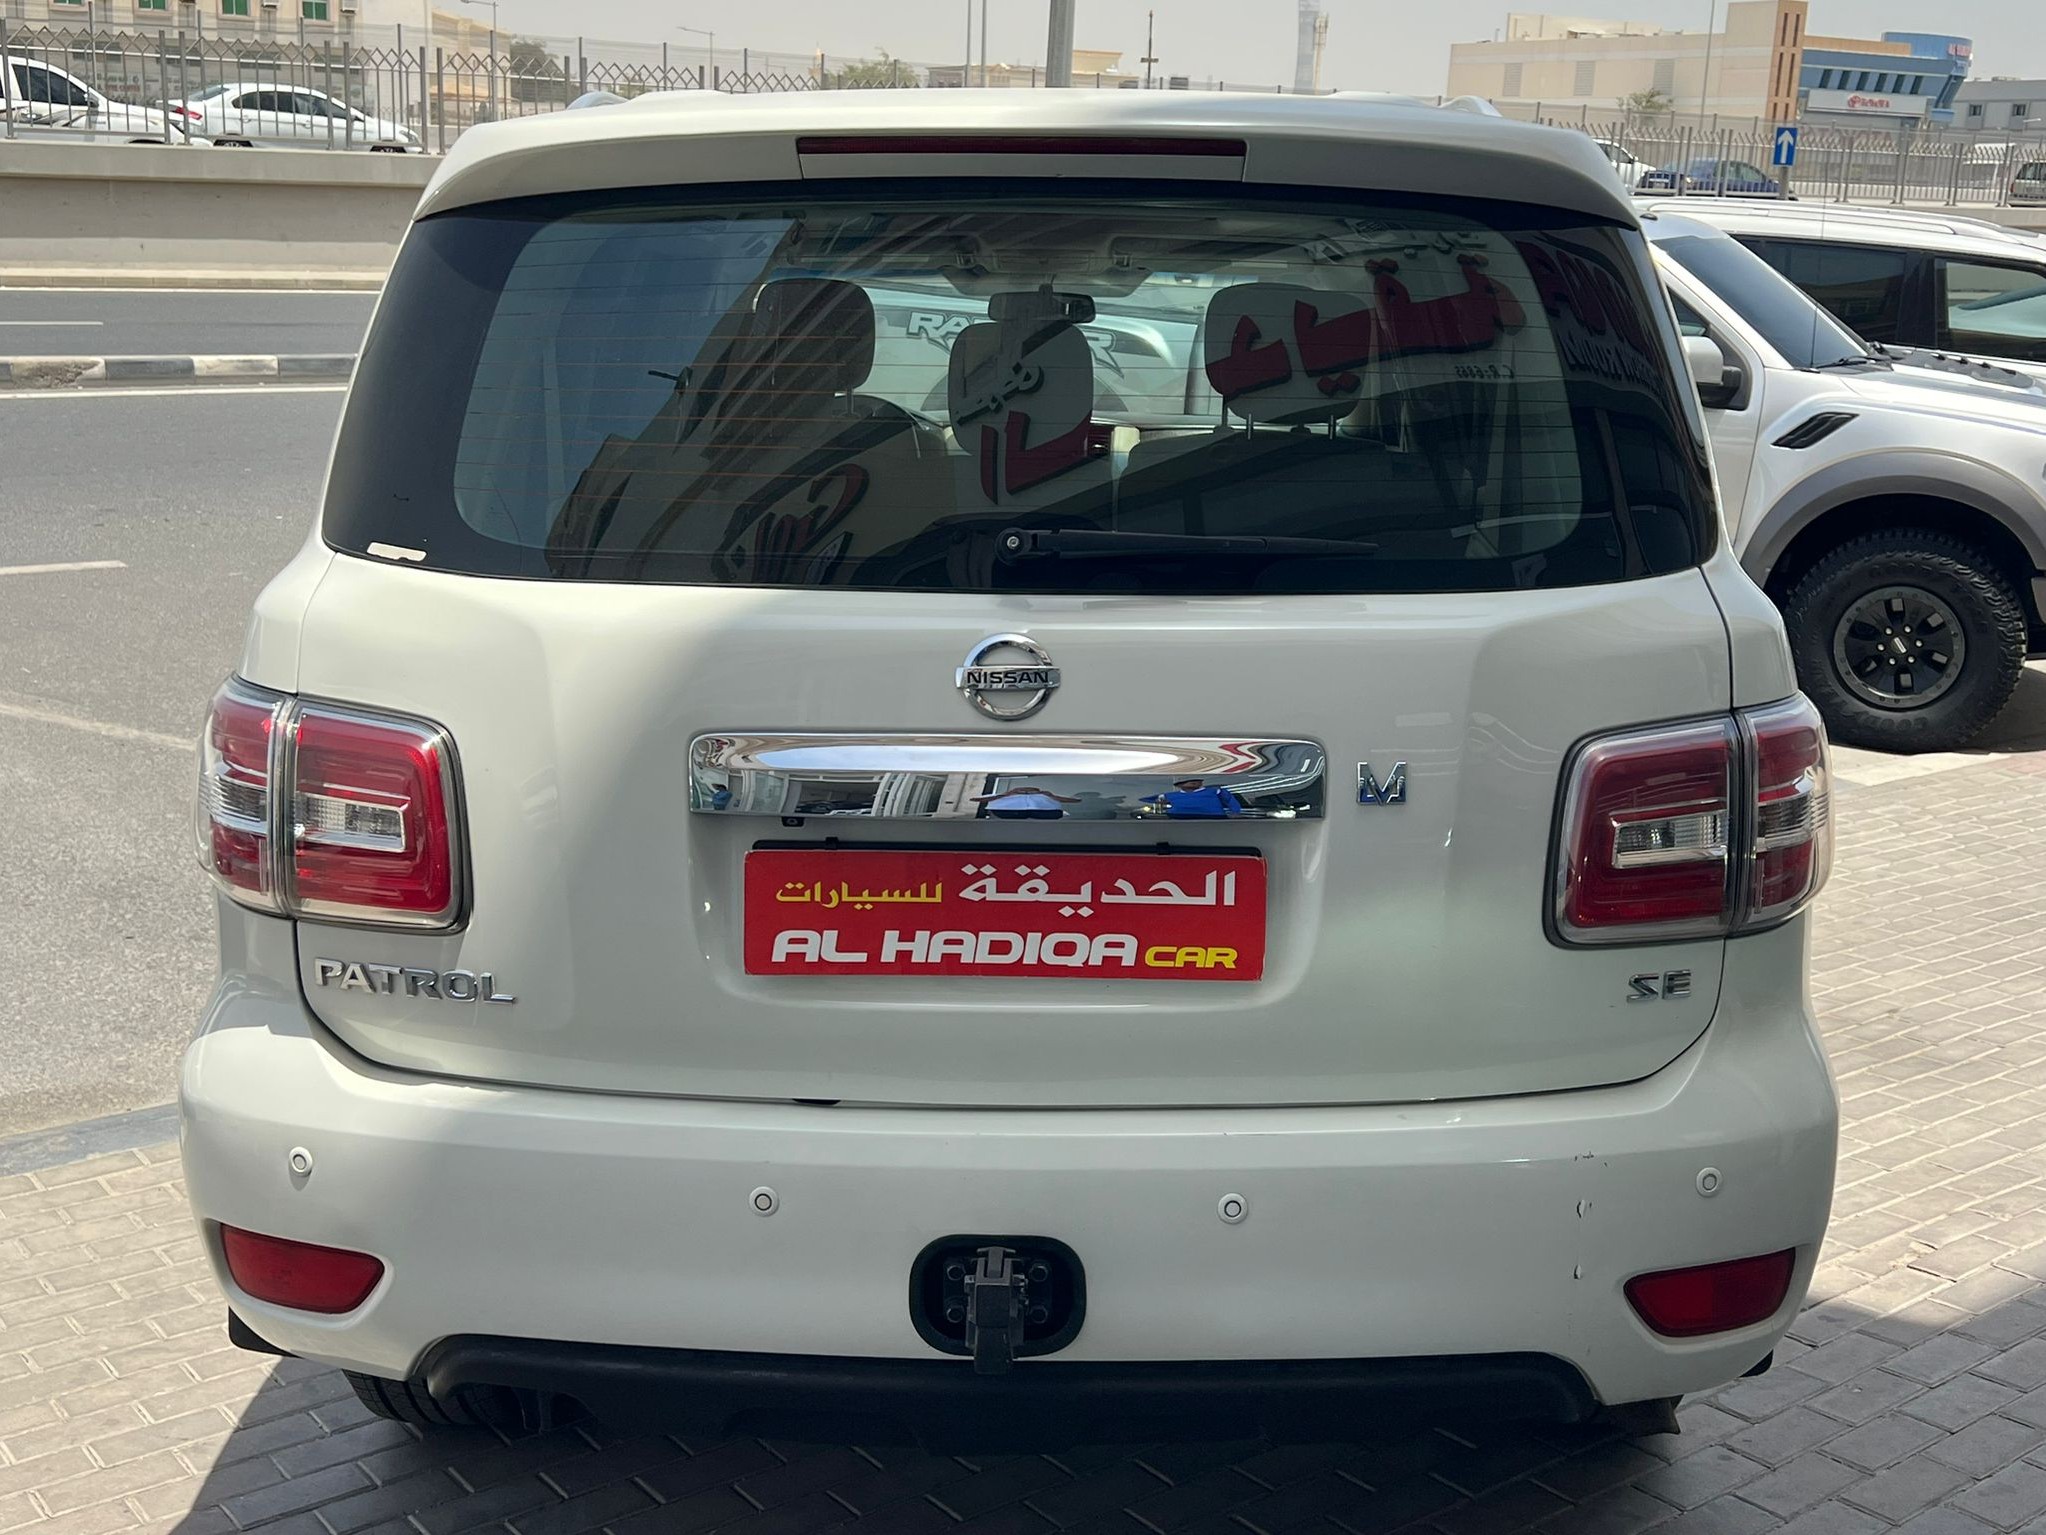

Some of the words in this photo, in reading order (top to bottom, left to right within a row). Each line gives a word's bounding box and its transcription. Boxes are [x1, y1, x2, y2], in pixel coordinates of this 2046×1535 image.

[906, 311, 1125, 379] RAR
[966, 671, 1049, 684] NISSAN
[1357, 761, 1407, 806] M
[775, 881, 943, 910] للسيارات
[958, 863, 1236, 918] الحديقة
[771, 929, 868, 964] AL
[880, 930, 1139, 969] HADIQA
[1144, 945, 1239, 969] CAR
[314, 957, 518, 1005] PATROL
[1626, 968, 1693, 1003] SE
